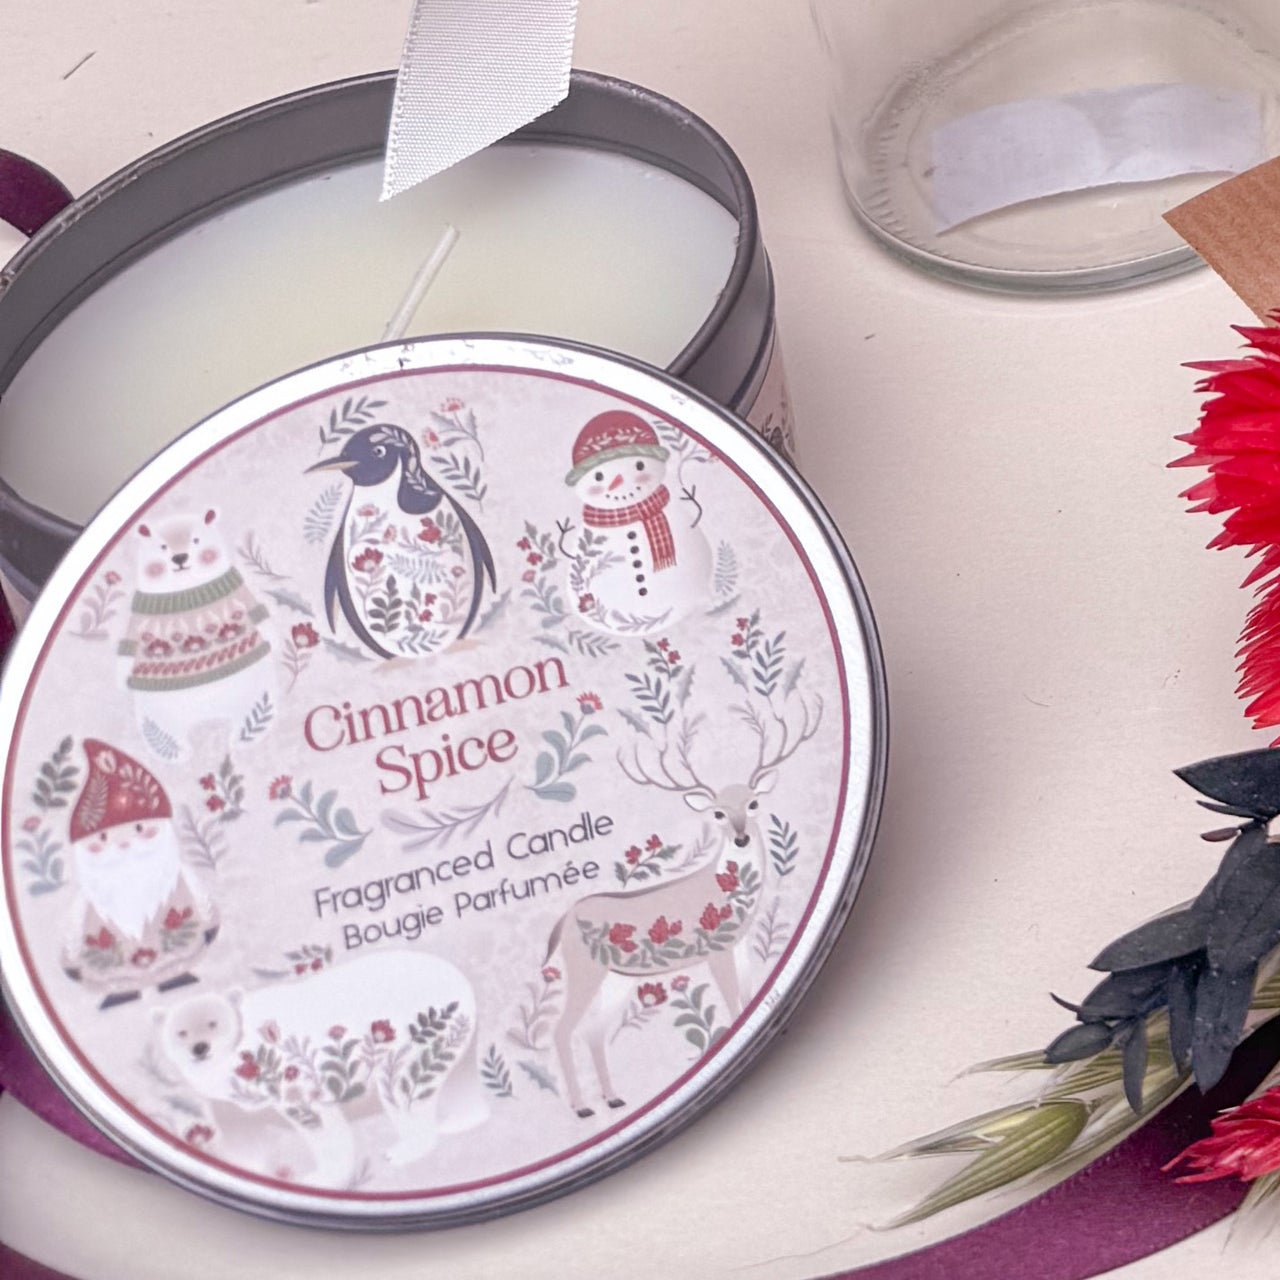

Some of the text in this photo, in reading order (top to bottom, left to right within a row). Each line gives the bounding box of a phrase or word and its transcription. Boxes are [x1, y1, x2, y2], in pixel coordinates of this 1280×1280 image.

[304, 656, 569, 752] Cinnamon
[375, 729, 518, 801] Spice
[314, 812, 614, 918] Fragranced Candle
[342, 860, 600, 950] Bougie Parfumée
